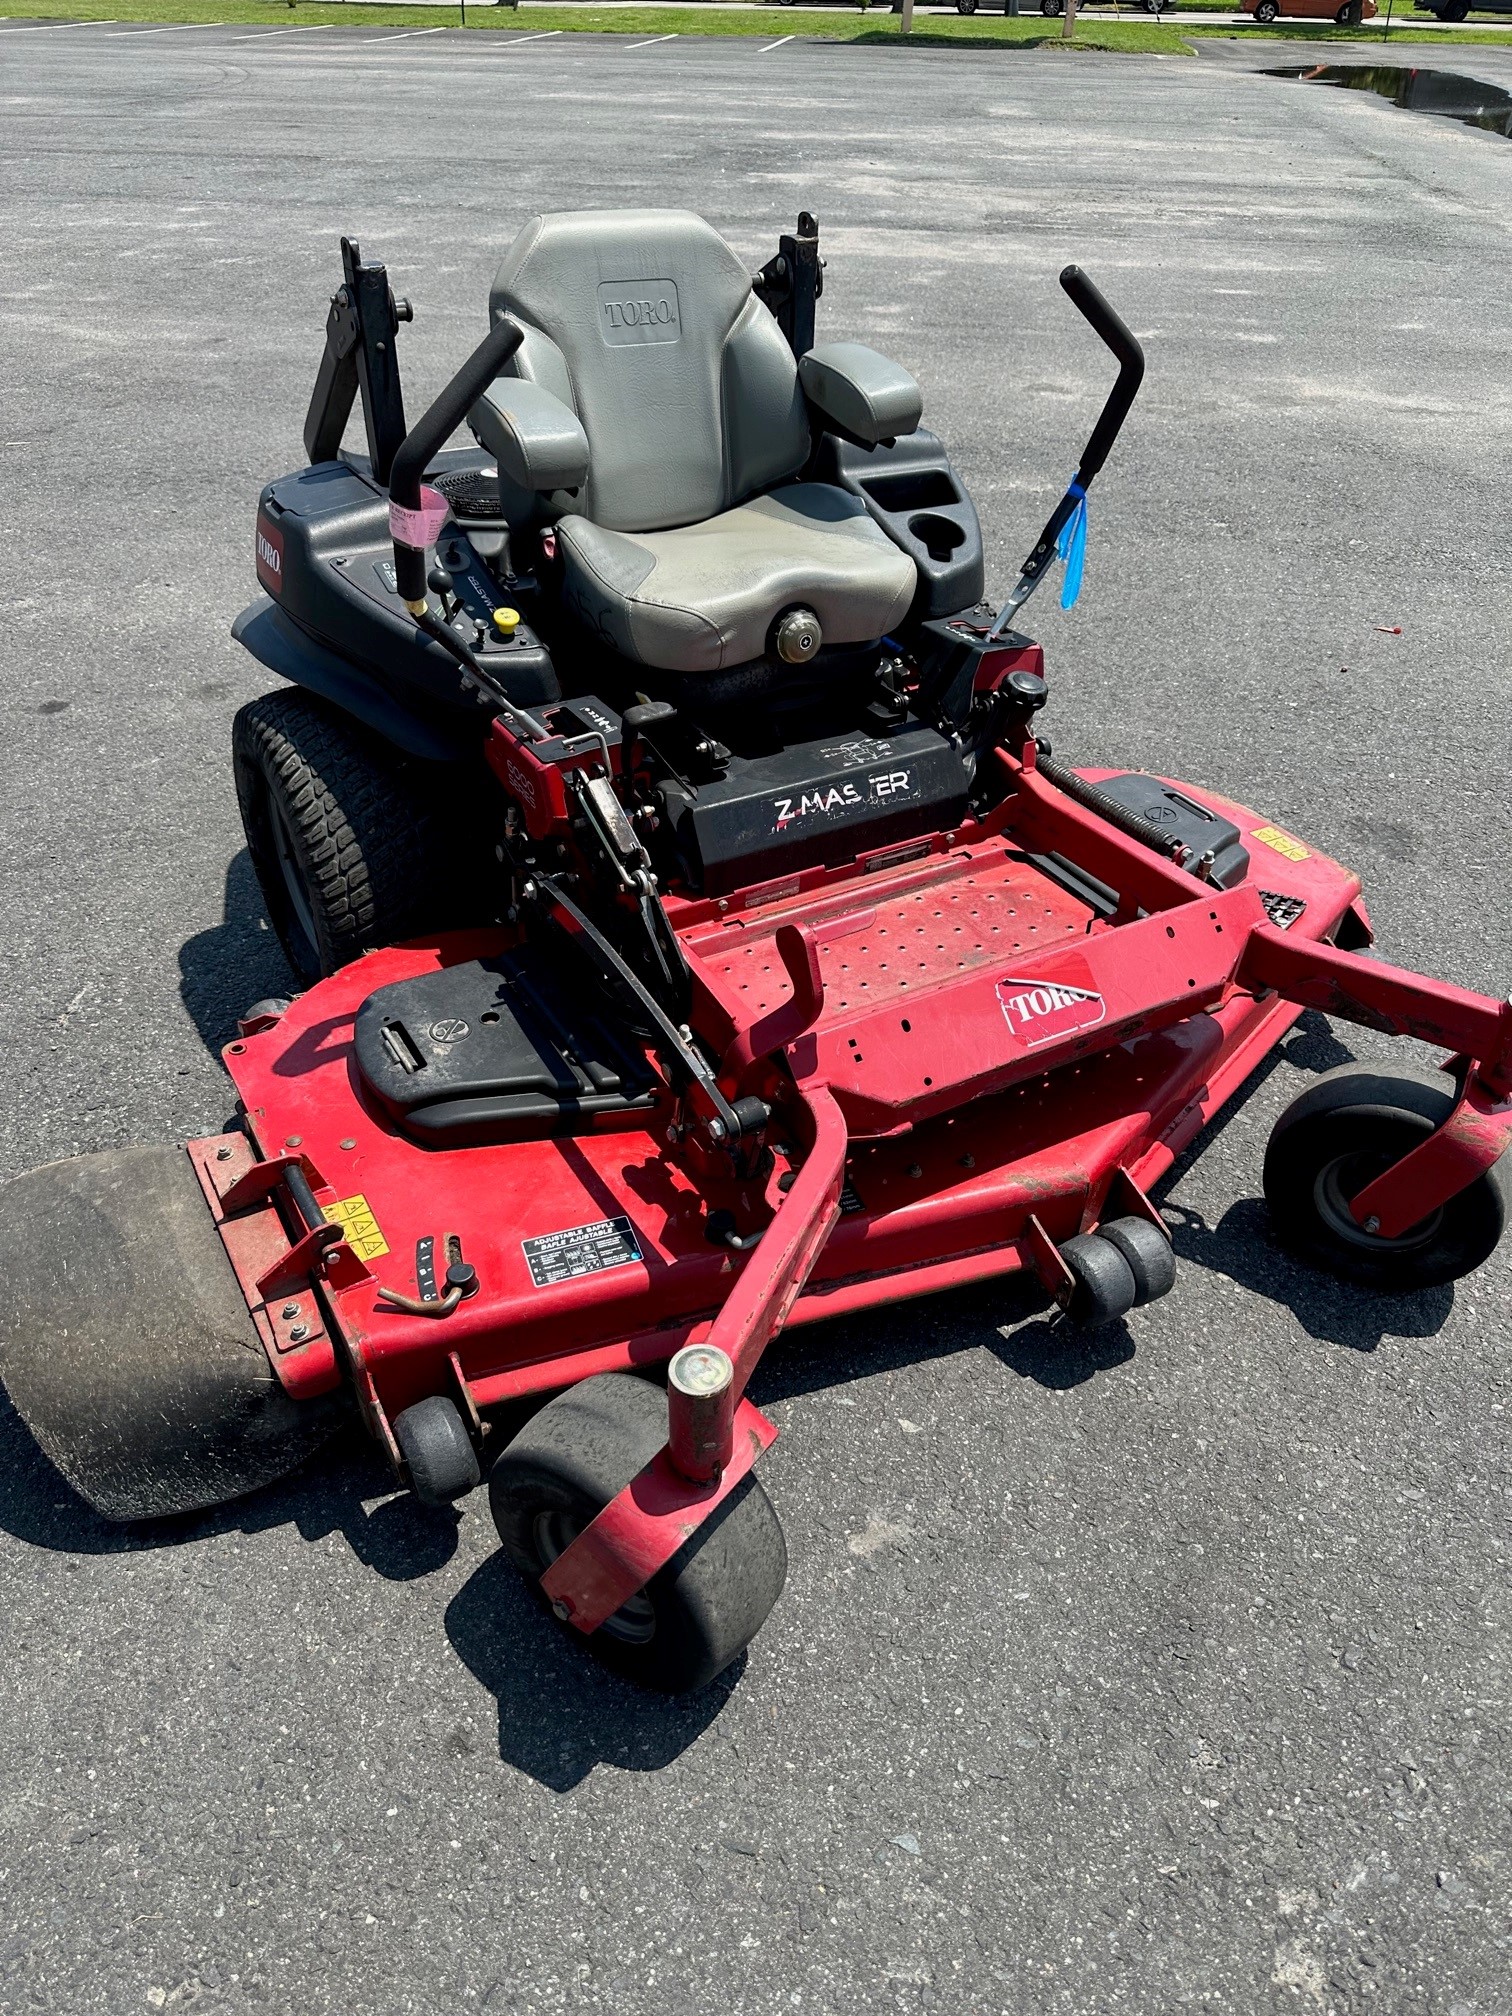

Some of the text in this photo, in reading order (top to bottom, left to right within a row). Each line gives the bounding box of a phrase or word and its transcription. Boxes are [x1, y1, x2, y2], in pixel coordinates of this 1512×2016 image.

[604, 299, 674, 327] TORO
[257, 532, 280, 572] TORO
[467, 576, 494, 607] MASTER
[506, 759, 535, 796] 6000
[508, 773, 537, 809] SERIES
[774, 798, 796, 821] Z
[534, 1228, 584, 1246] ADJUSTABLE
[586, 1221, 616, 1233] BAFFLE
[540, 1238, 567, 1251] BAFLE
[569, 1227, 613, 1244] AJUSTABLE
